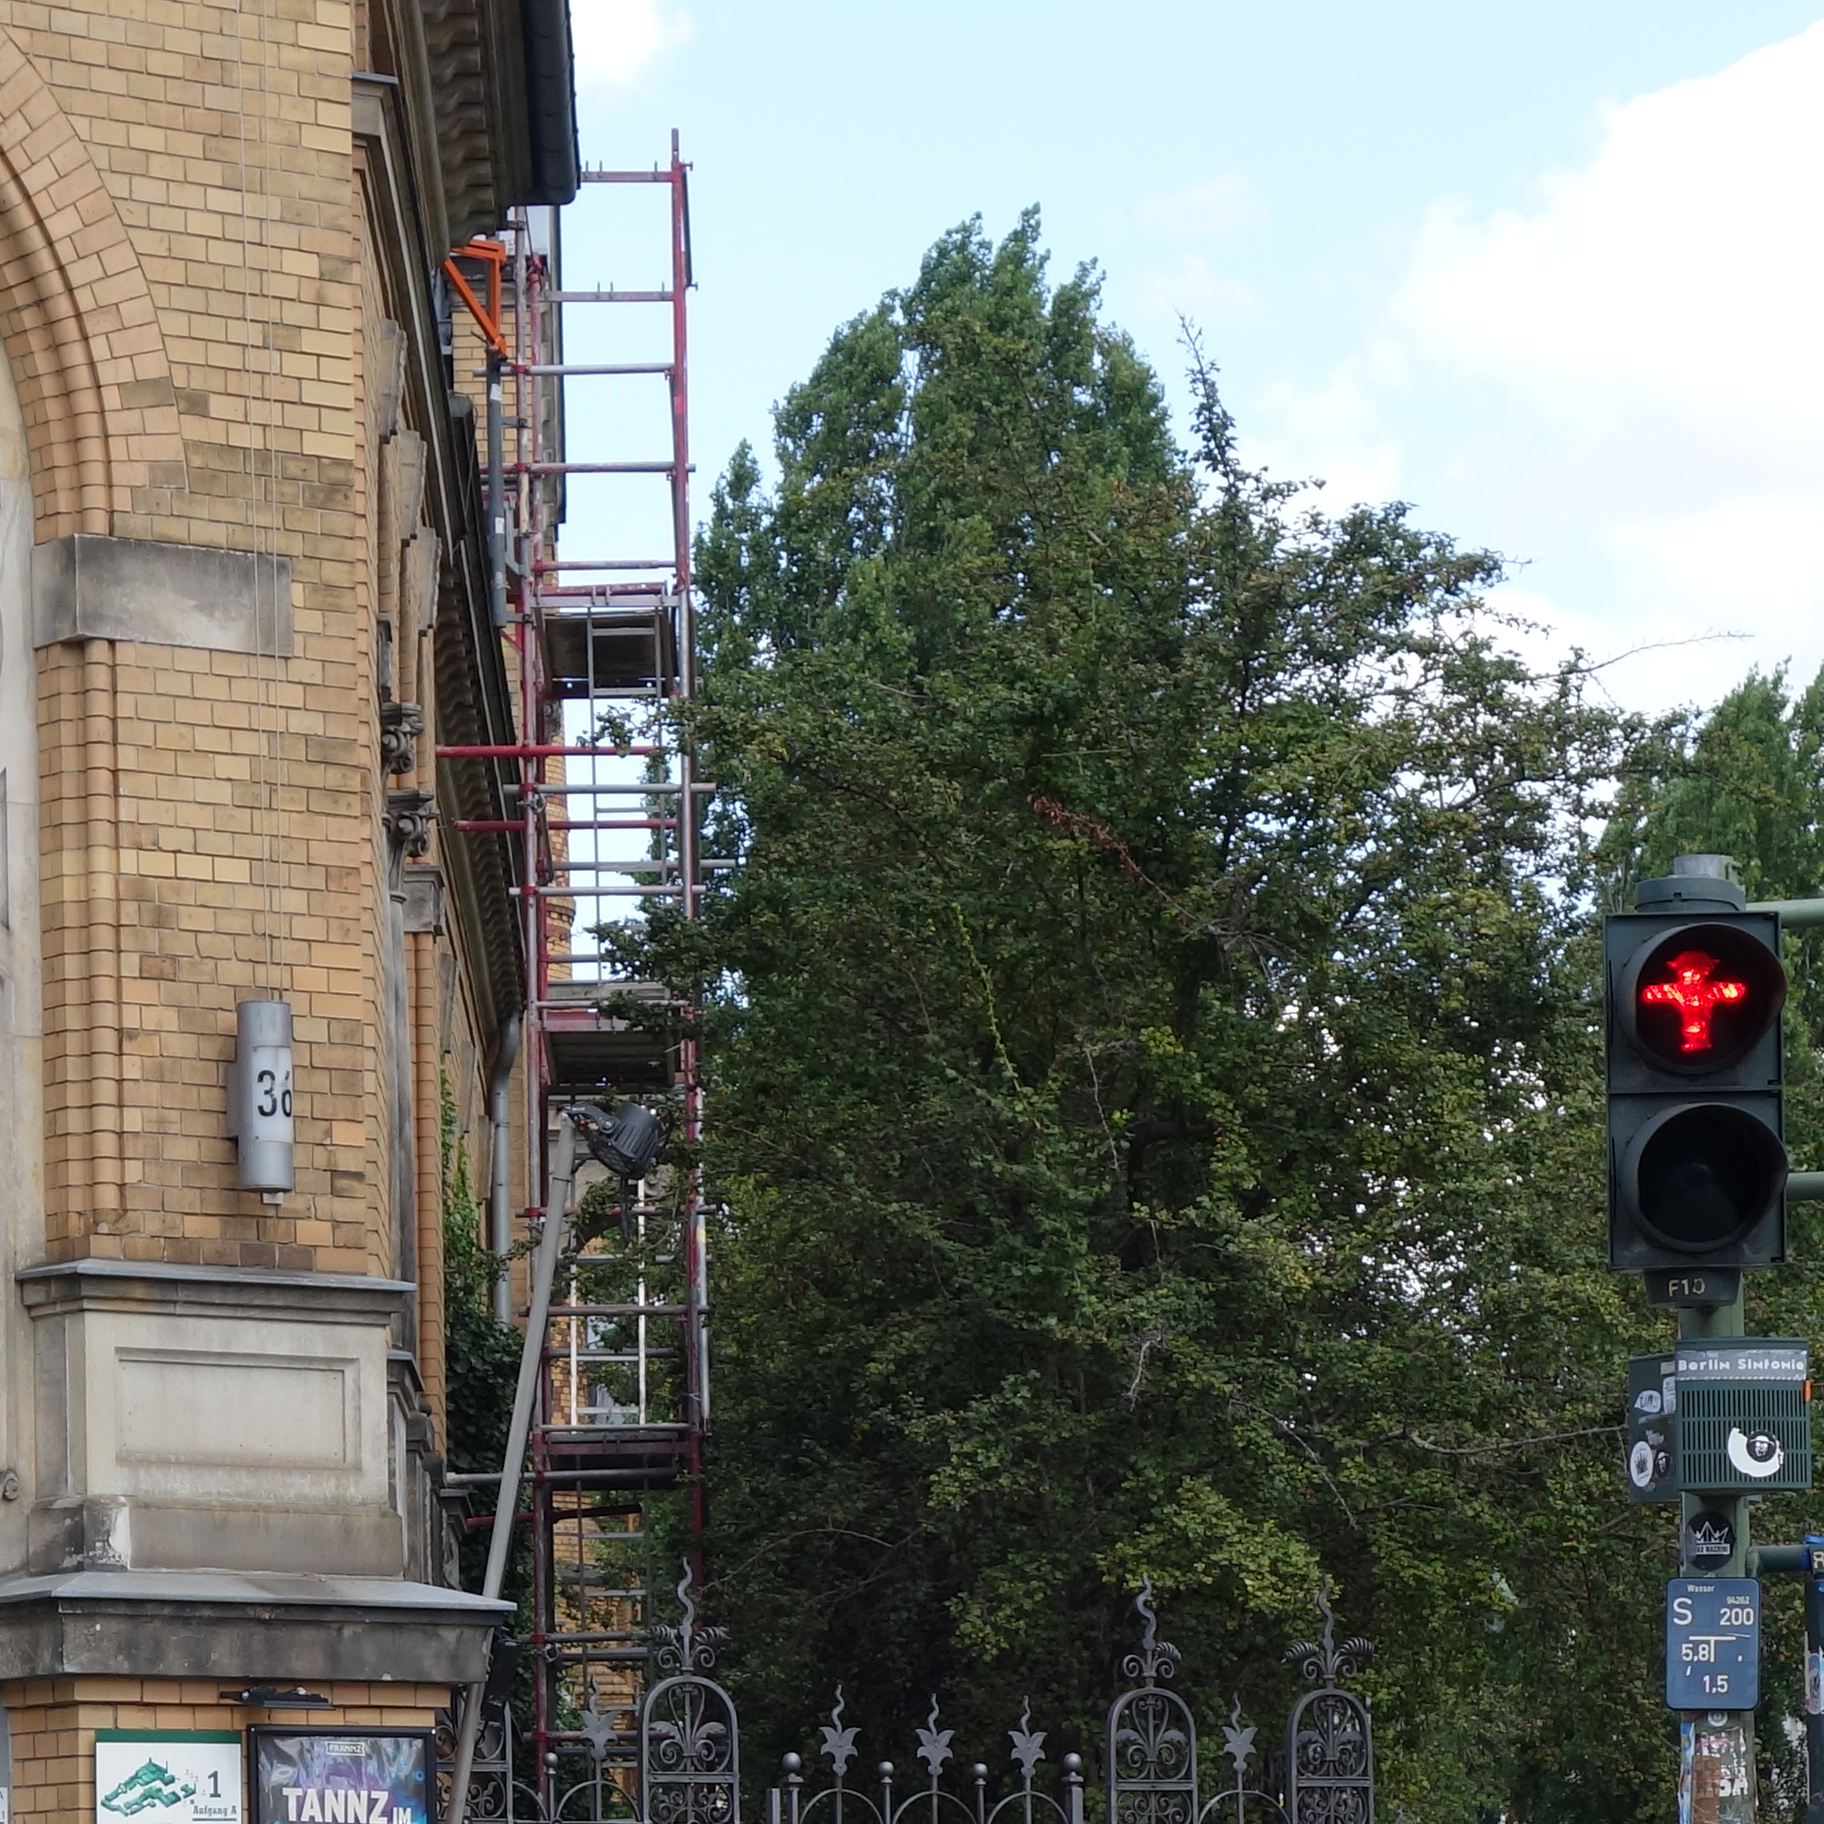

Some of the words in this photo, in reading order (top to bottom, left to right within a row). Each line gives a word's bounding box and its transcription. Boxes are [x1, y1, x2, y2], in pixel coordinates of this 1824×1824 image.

[257, 1069, 292, 1118] 36
[1669, 1278, 1706, 1297] F10
[1678, 1359, 1730, 1371] Berlin
[1738, 1358, 1805, 1371] Sinfonie
[1687, 1584, 1715, 1593] Wasser
[1673, 1597, 1693, 1625] S
[1719, 1608, 1754, 1626] 200
[1681, 1643, 1709, 1663] 5,8
[1702, 1675, 1728, 1694] 1,5
[329, 1744, 362, 1753] FRANNZ
[207, 1771, 221, 1798] 1
[282, 1787, 389, 1824] TANNZ
